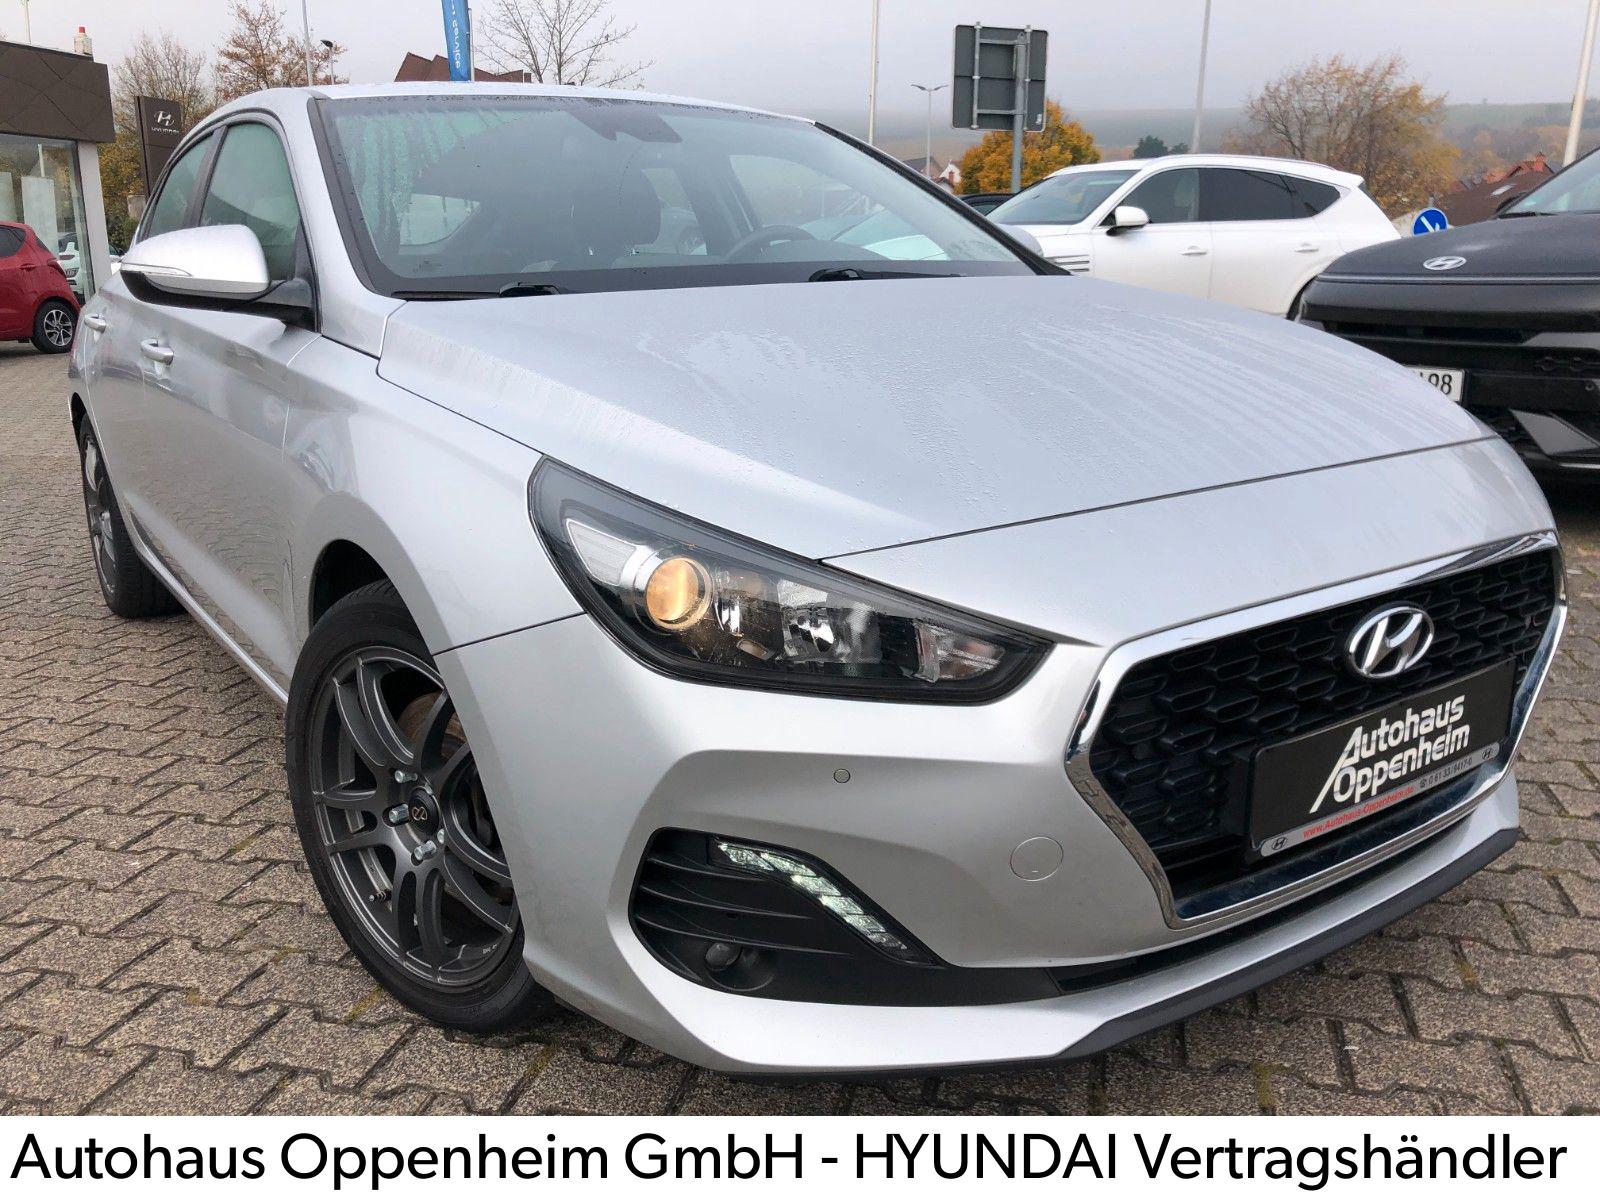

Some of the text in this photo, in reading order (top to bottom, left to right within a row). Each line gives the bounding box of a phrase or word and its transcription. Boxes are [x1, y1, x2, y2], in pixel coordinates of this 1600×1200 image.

[1420, 371, 1453, 396] 98
[1310, 694, 1466, 814] Autohaus
[1333, 724, 1471, 804] Oppenheim
